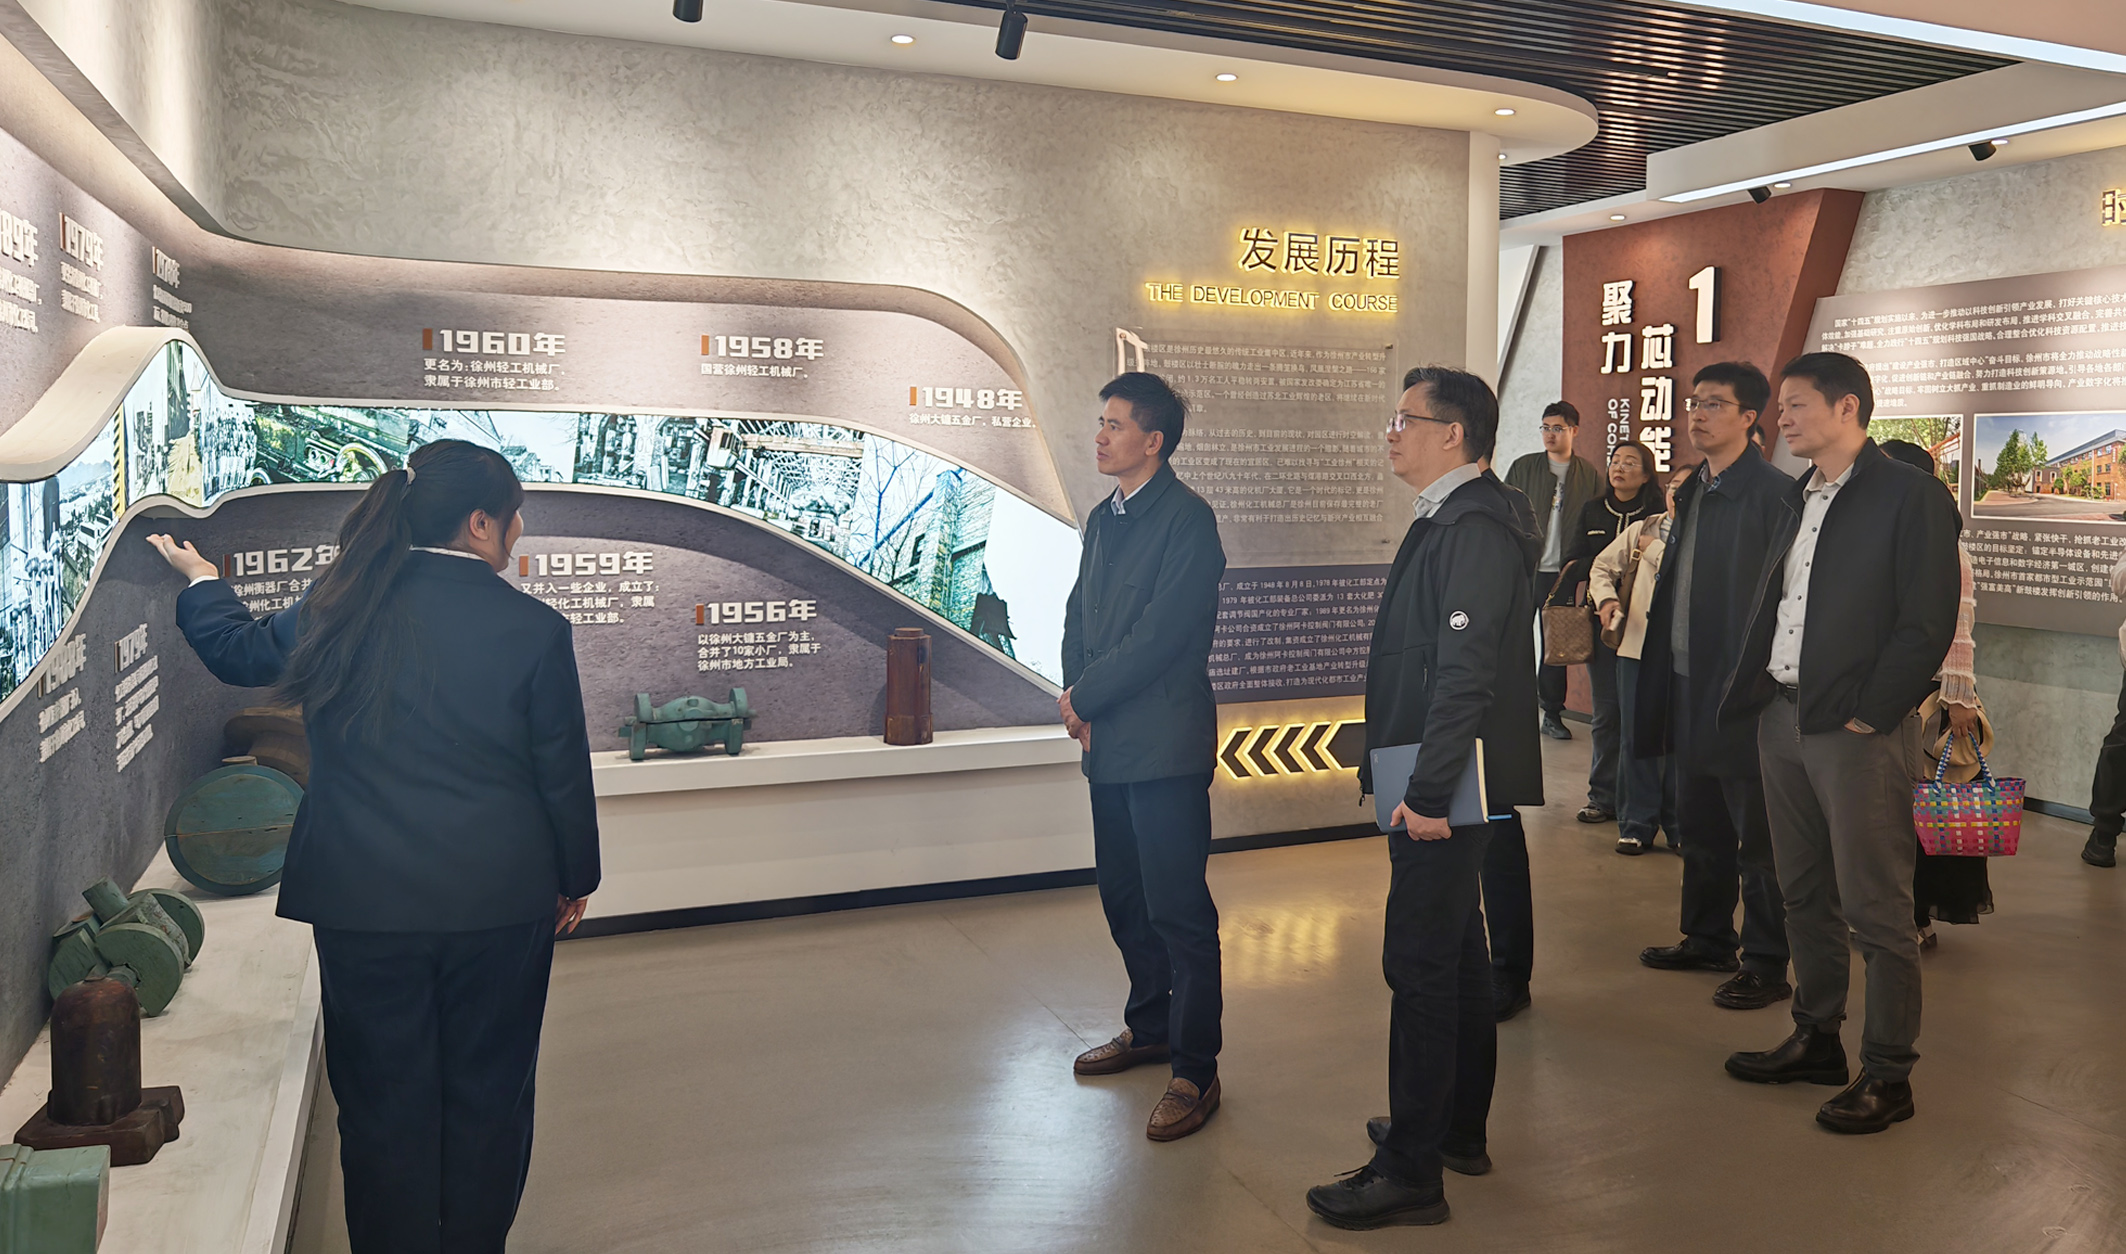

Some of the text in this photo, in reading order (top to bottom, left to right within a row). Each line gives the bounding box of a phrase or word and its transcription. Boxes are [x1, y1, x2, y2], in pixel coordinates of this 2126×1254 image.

[0, 207, 38, 267] 89年
[1239, 228, 1400, 278] 发展历程
[1146, 283, 1398, 312] THE DEVELOPMENT COURSE
[1689, 266, 1715, 343] 1
[1600, 279, 1633, 374] 聚力
[440, 329, 566, 356] 1960年
[715, 336, 824, 360] 1958年
[424, 375, 560, 391] 隶属于徐州市轻工业部。
[922, 387, 1022, 410] 1948年
[1607, 399, 1618, 420] OF
[1639, 323, 1674, 472] 芯动能
[233, 544, 340, 576] 1962年
[535, 551, 653, 576] 1959年
[242, 595, 304, 612] 州化工机
[707, 599, 817, 624] 1956年
